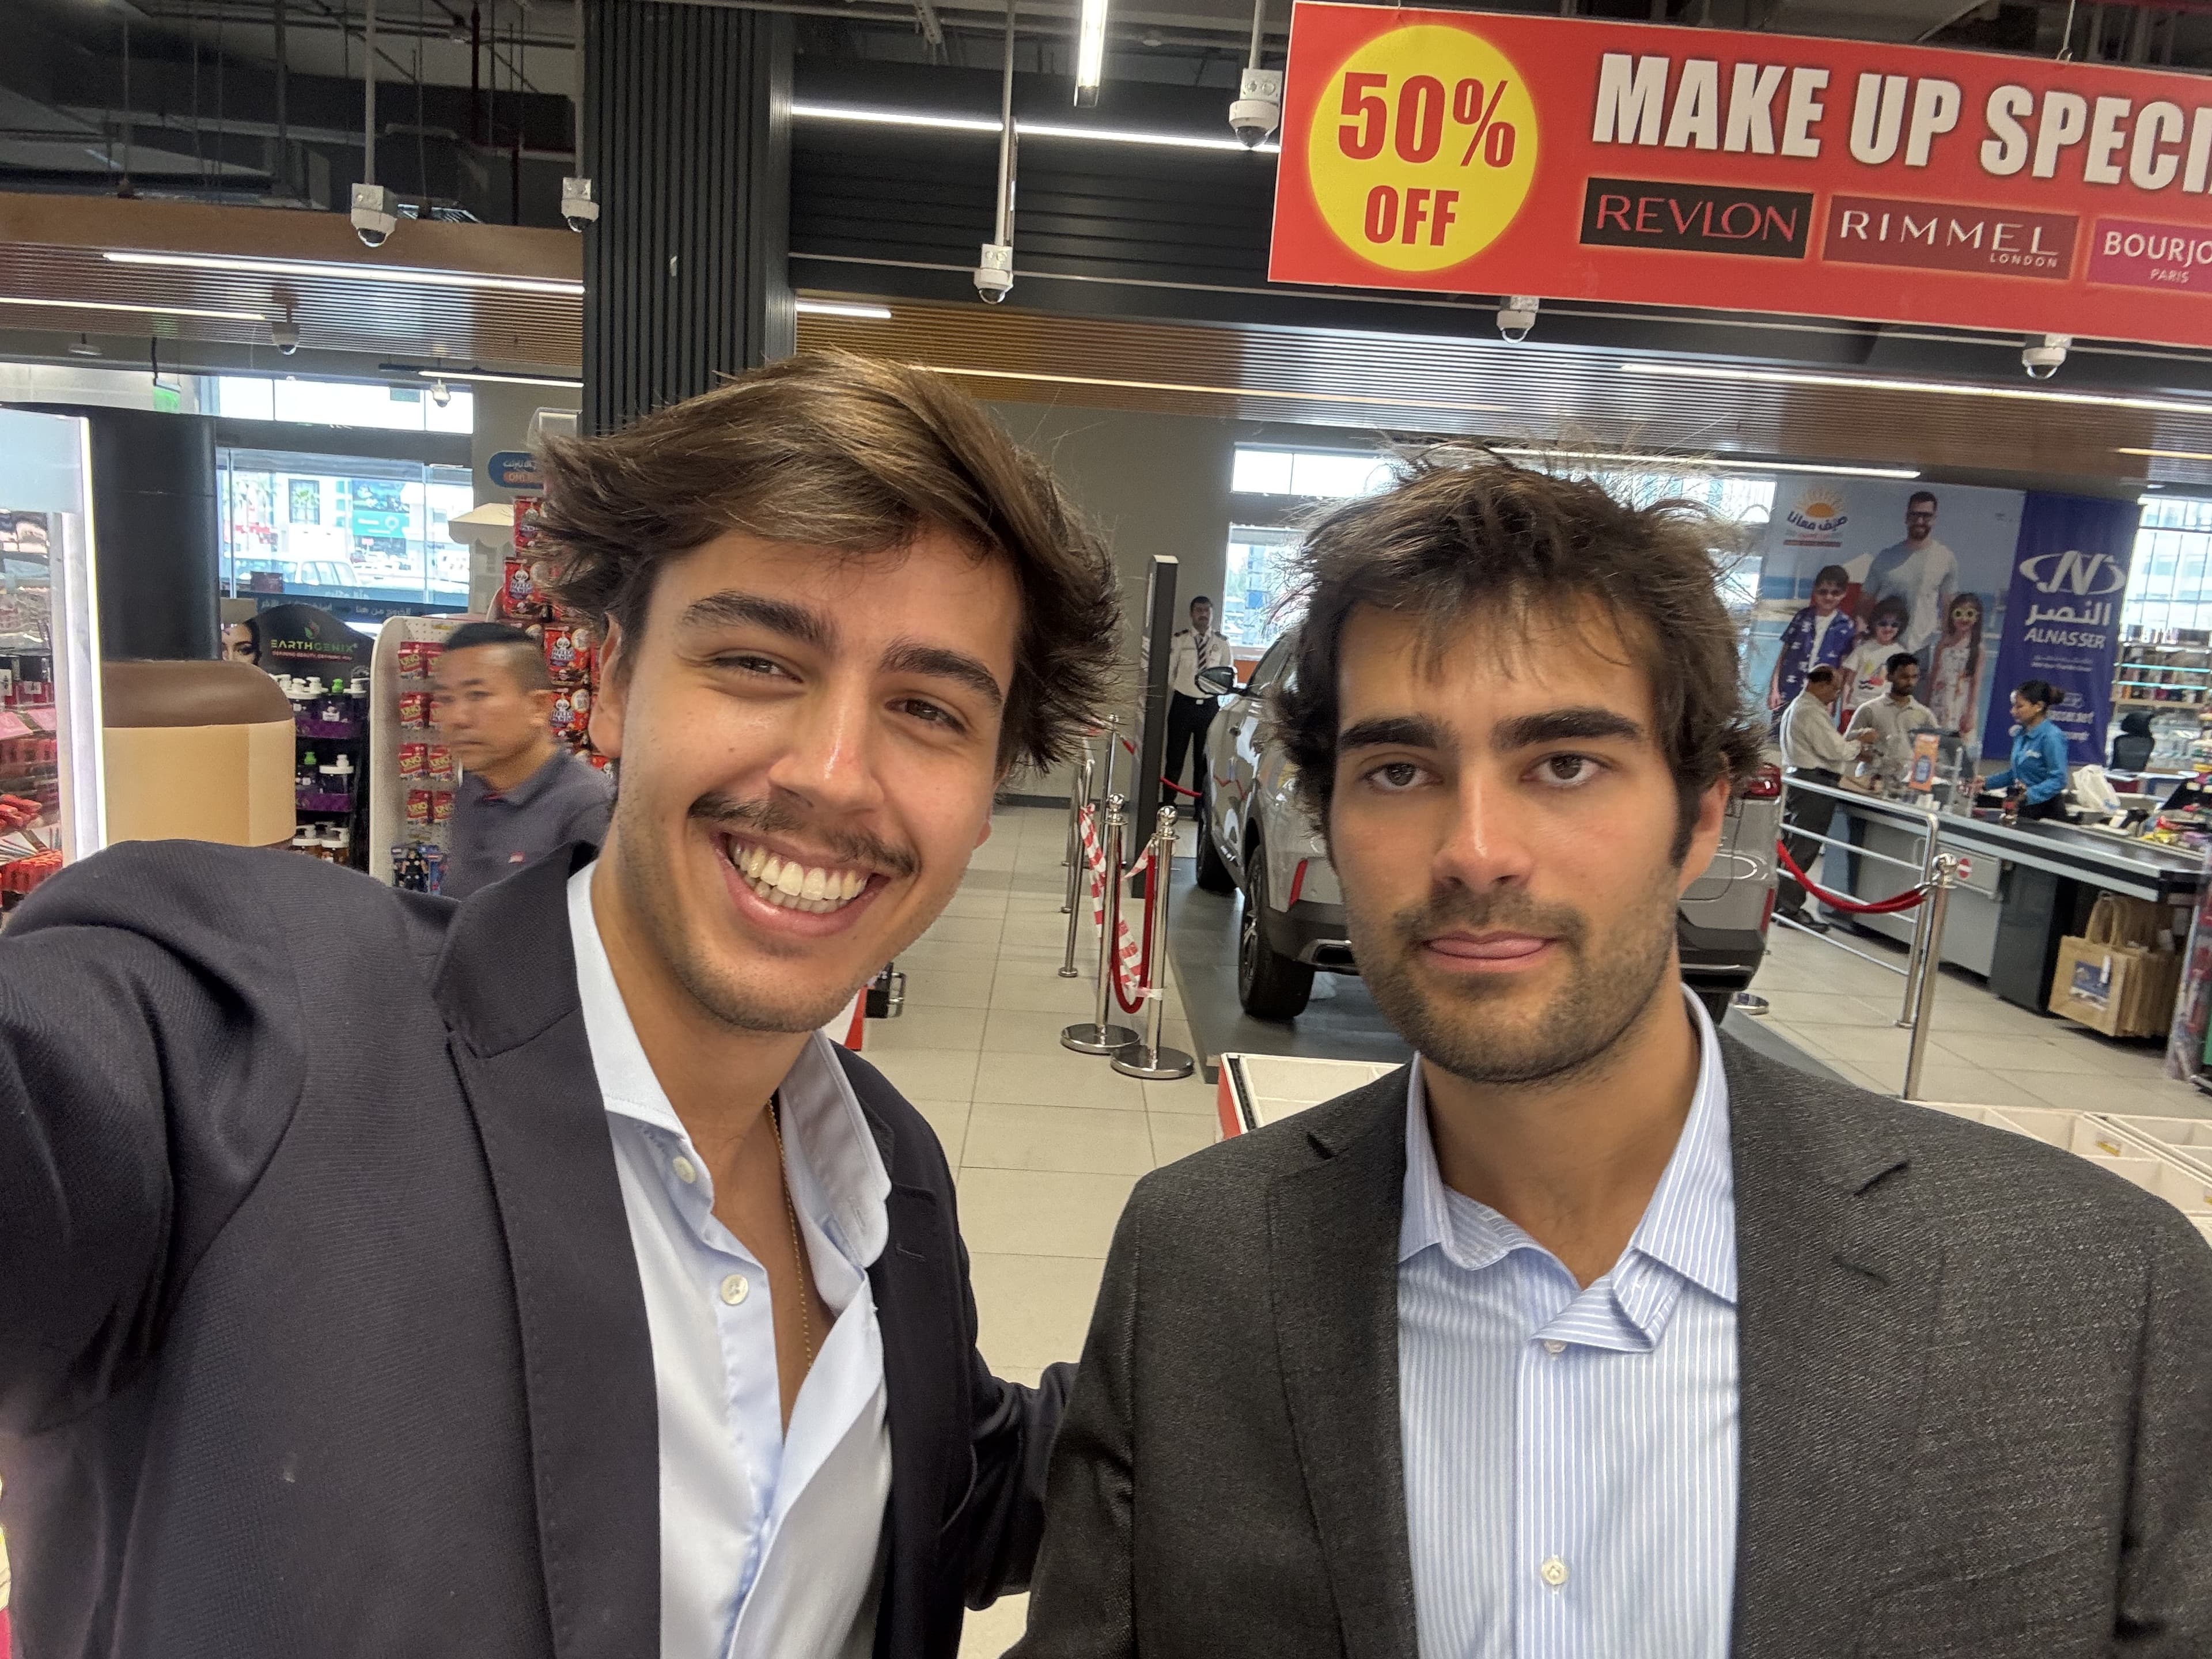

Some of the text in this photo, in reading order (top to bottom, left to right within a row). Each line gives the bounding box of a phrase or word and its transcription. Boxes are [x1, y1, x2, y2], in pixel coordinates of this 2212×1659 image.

[1339, 72, 1516, 168] 50%
[1592, 52, 2212, 194] MAKE UP SPECI
[1364, 185, 1460, 247] OFF
[1596, 194, 1797, 242] REVLON
[1840, 210, 2059, 256] RIMMEL
[2104, 231, 2212, 268] BOURJO
[1990, 252, 2058, 268] LONDON
[2149, 268, 2190, 283] PARIS
[2024, 600, 2112, 626] النصر
[270, 639, 354, 653] EARTHGENIX
[2024, 627, 2107, 649] ALNASSER
[399, 653, 420, 667] UNO
[400, 704, 421, 718] UNO
[400, 755, 422, 768] UNO
[429, 756, 450, 768] UNO
[408, 801, 428, 813] UNO
